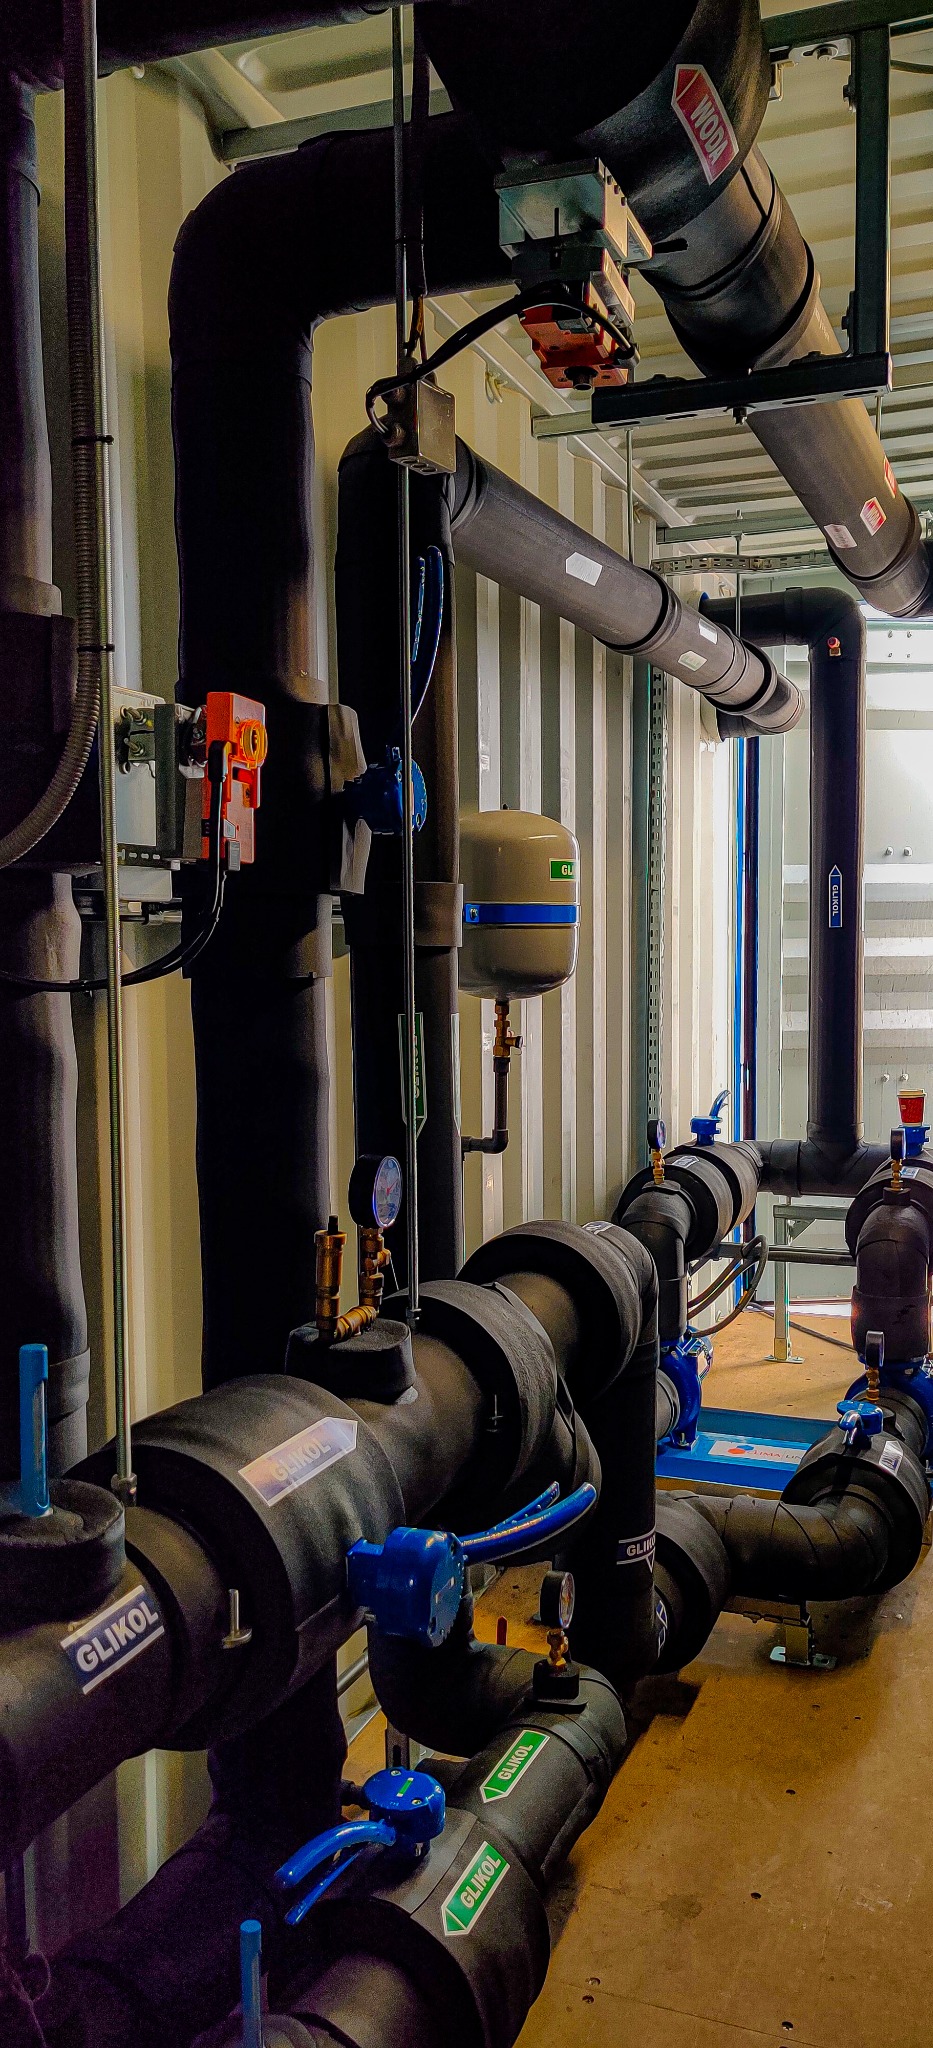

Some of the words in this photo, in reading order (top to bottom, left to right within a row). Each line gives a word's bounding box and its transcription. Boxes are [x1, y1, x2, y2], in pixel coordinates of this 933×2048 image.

[690, 94, 728, 166] WODA
[270, 1438, 332, 1482] GLIKOL
[76, 1601, 159, 1672] GLIKOL
[497, 1743, 533, 1781] GLIKOL
[460, 1854, 502, 1909] GLIKOL
